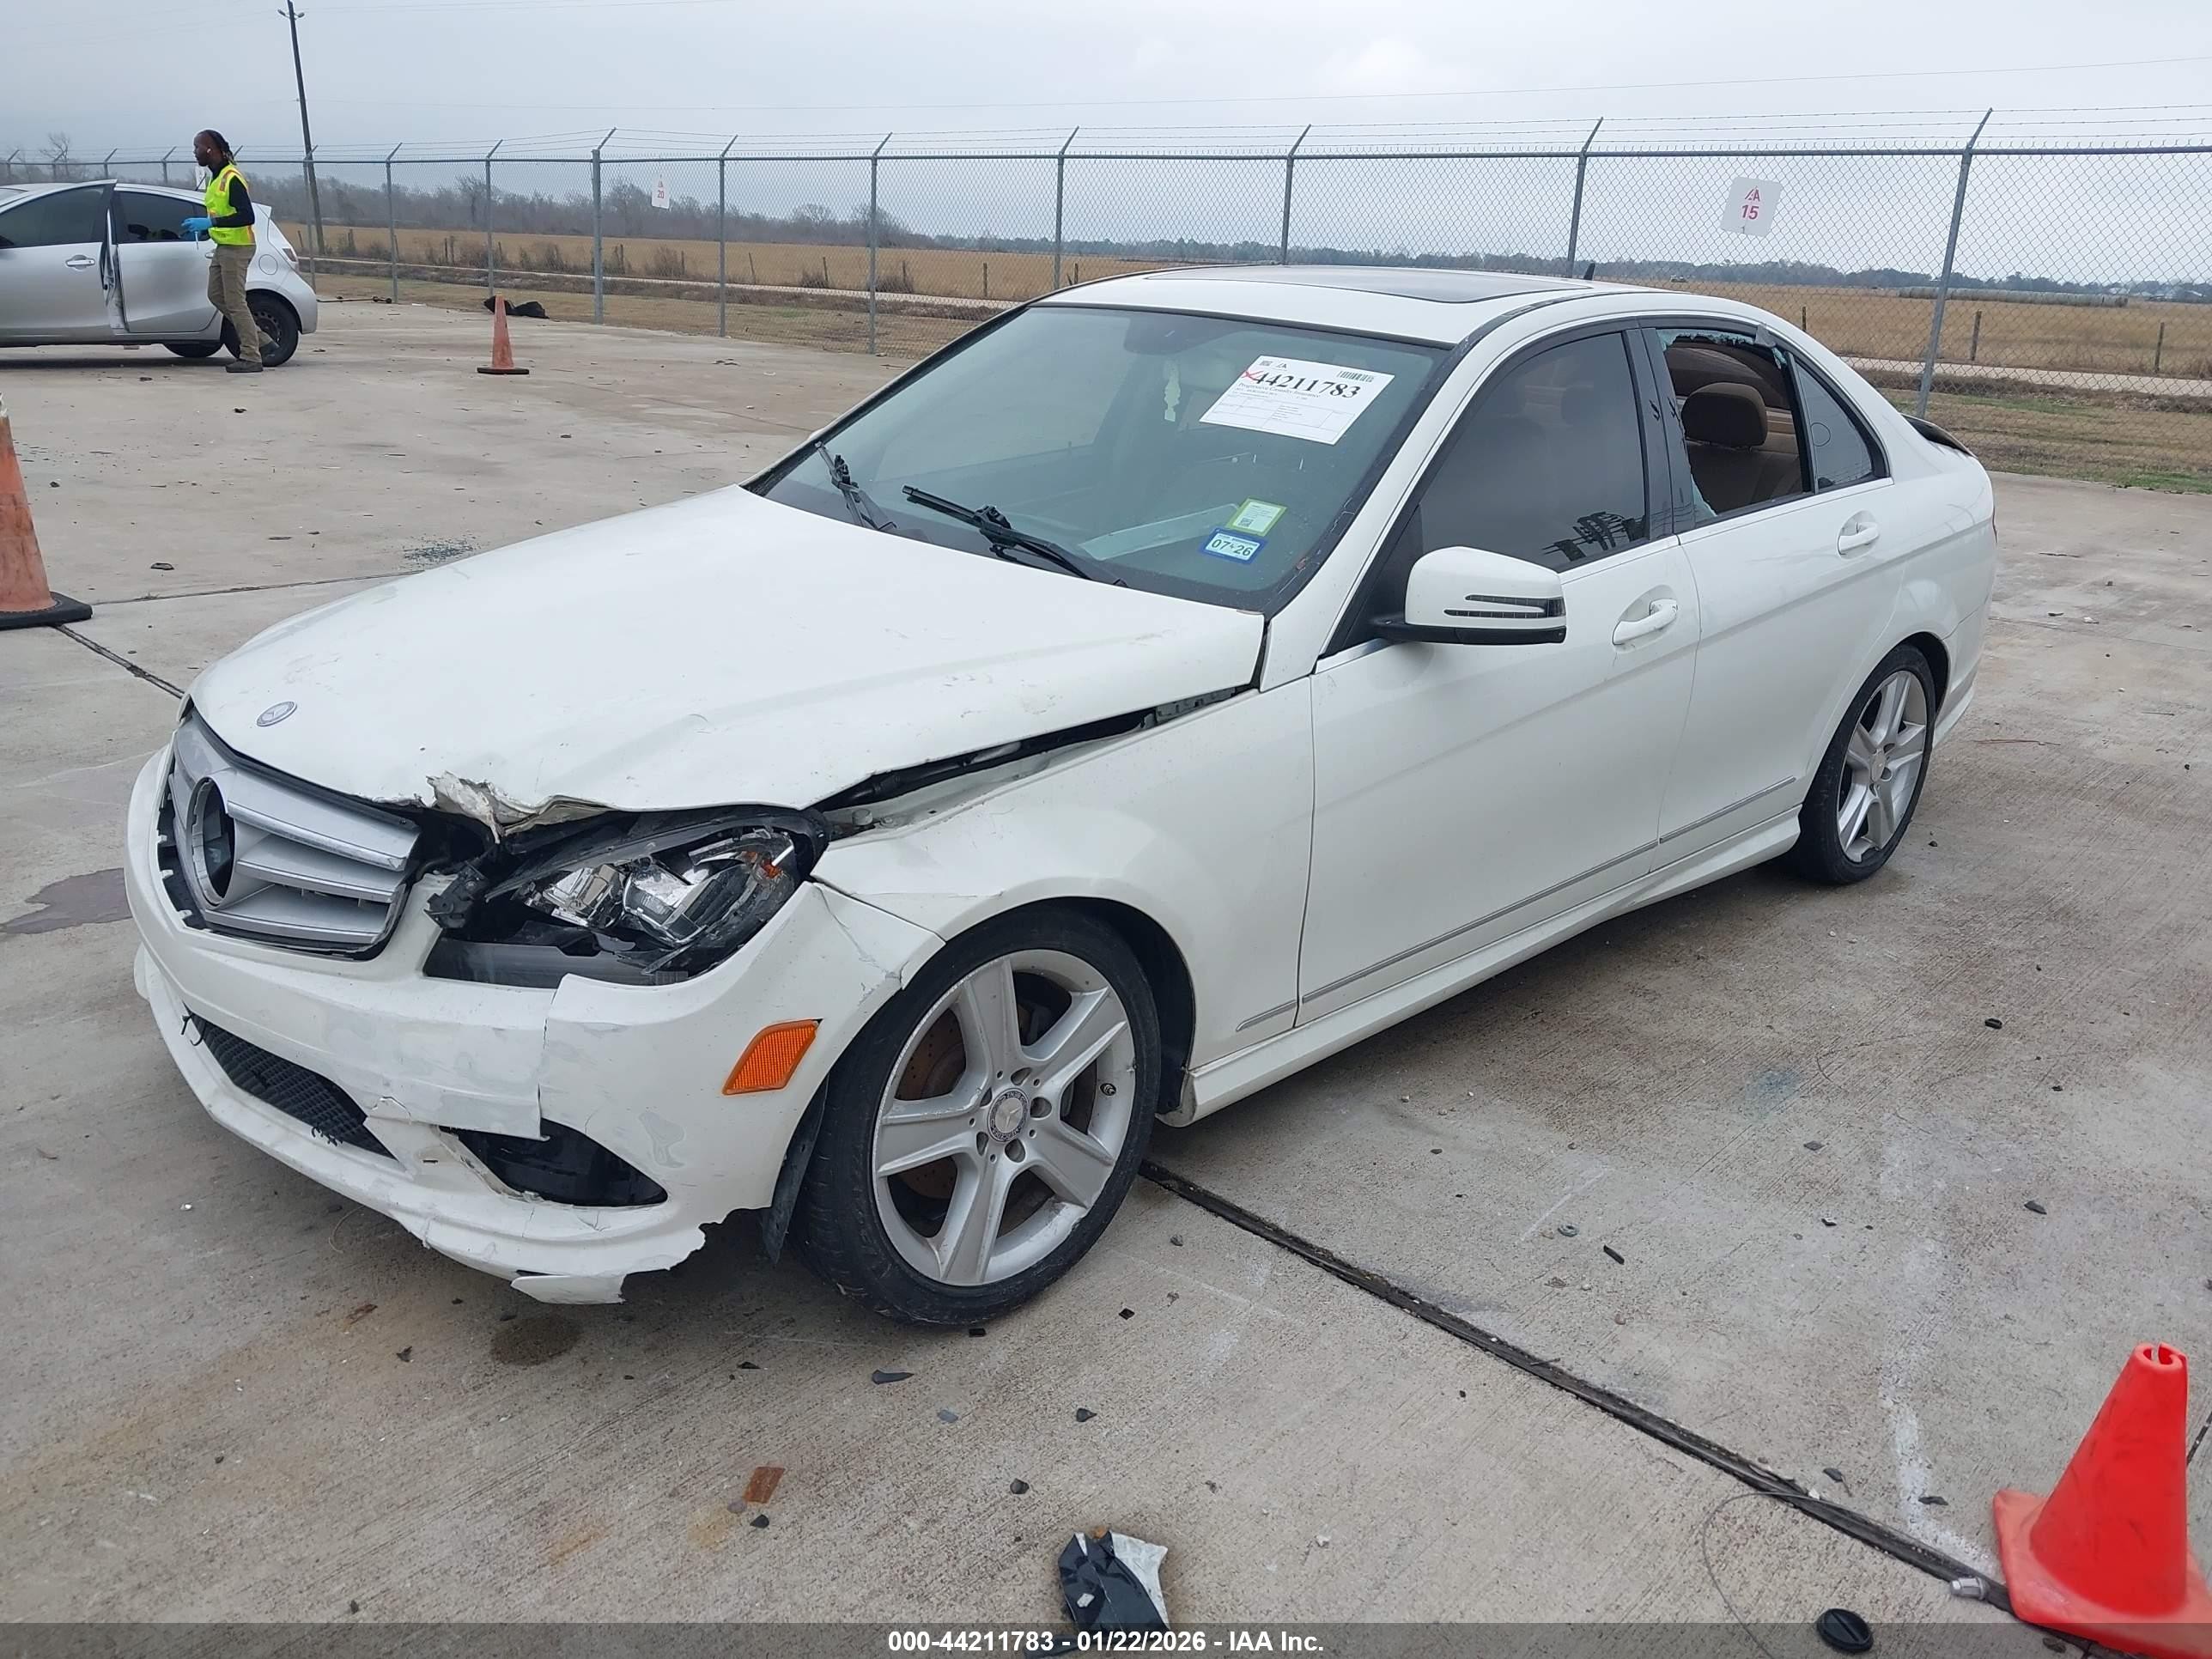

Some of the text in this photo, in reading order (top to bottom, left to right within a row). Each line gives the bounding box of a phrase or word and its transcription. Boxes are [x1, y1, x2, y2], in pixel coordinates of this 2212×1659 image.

[1742, 204, 1759, 220] 15
[1251, 372, 1361, 399] 44211783
[1211, 538, 1231, 550] 07
[1233, 544, 1253, 556] 26
